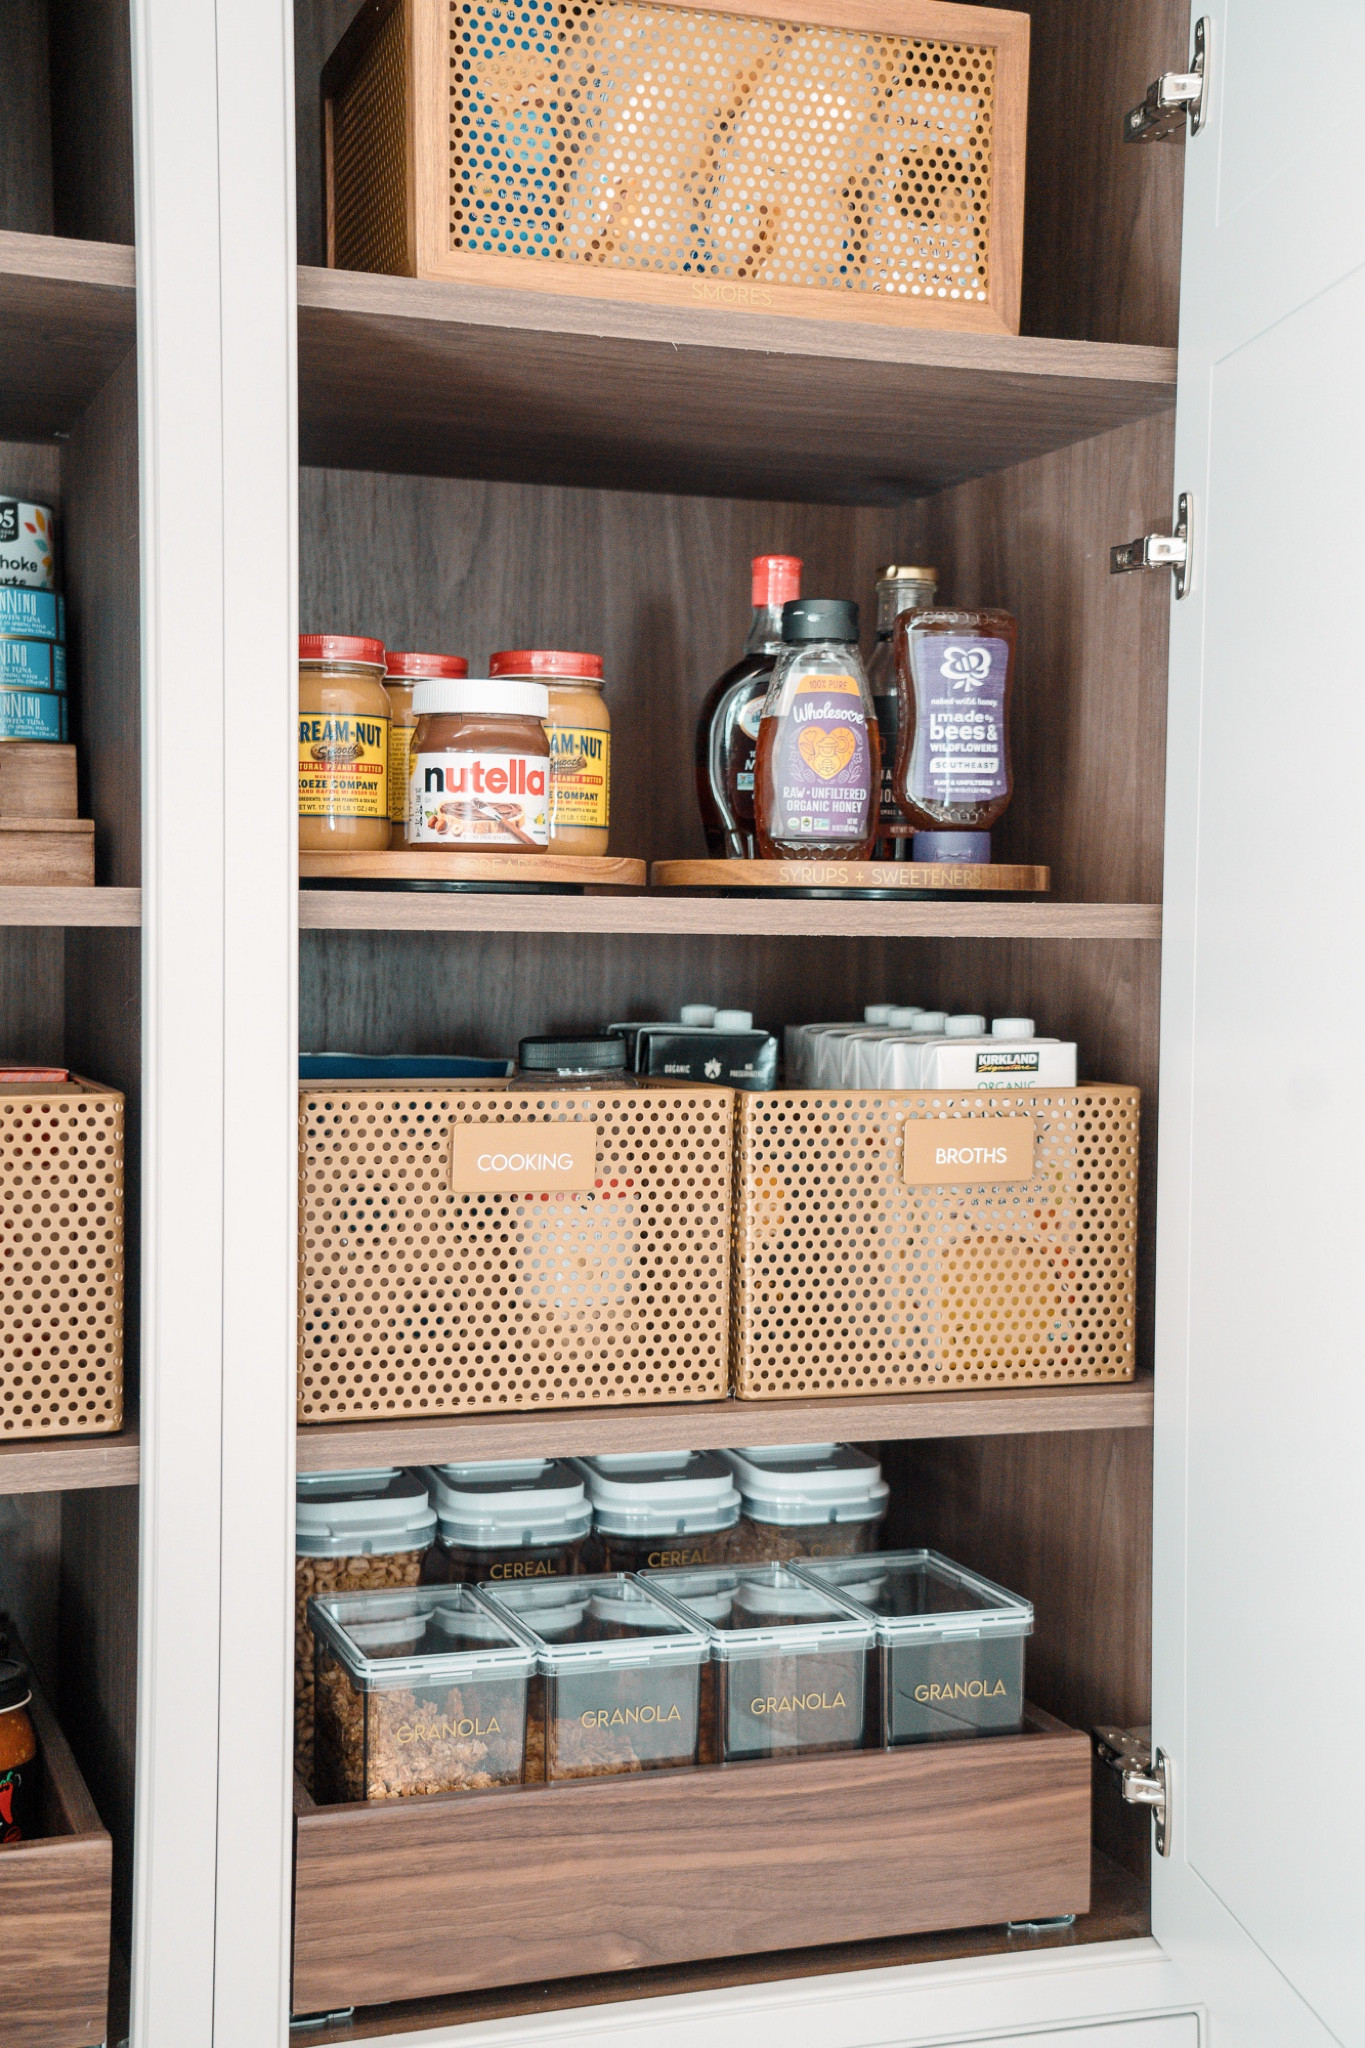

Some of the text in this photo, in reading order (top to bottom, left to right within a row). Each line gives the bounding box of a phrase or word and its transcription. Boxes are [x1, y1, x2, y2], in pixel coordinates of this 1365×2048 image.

[692, 281, 772, 306] SMORES
[828, 680, 848, 690] PURE
[937, 710, 984, 723] made
[299, 720, 382, 748] REAM-NUT
[930, 713, 999, 741] bees &
[929, 743, 999, 753] WILDFLOWERS
[327, 764, 357, 772] PEANUT
[358, 765, 382, 773] BUTTER
[424, 758, 545, 796] nutella
[330, 780, 379, 791] COMPANY
[782, 786, 806, 799] RAW
[811, 787, 867, 801] UNFILTERED
[556, 791, 599, 802] COMPANY
[786, 800, 863, 813] ORGANIC HONEY
[779, 866, 849, 884] SYRUPS
[871, 868, 982, 886] SWEETENERS
[978, 1053, 1038, 1065] KIRKLAND
[476, 1153, 574, 1172] COOKING
[935, 1147, 1008, 1165] BROTHS
[648, 1548, 711, 1568] CEREAL
[489, 1559, 557, 1580] CEREAL
[914, 1678, 1008, 1703] GRANOLA
[750, 1691, 847, 1716] GRANOLA
[580, 1704, 682, 1730] GRANOLA
[396, 1716, 502, 1745] GRANOLA
